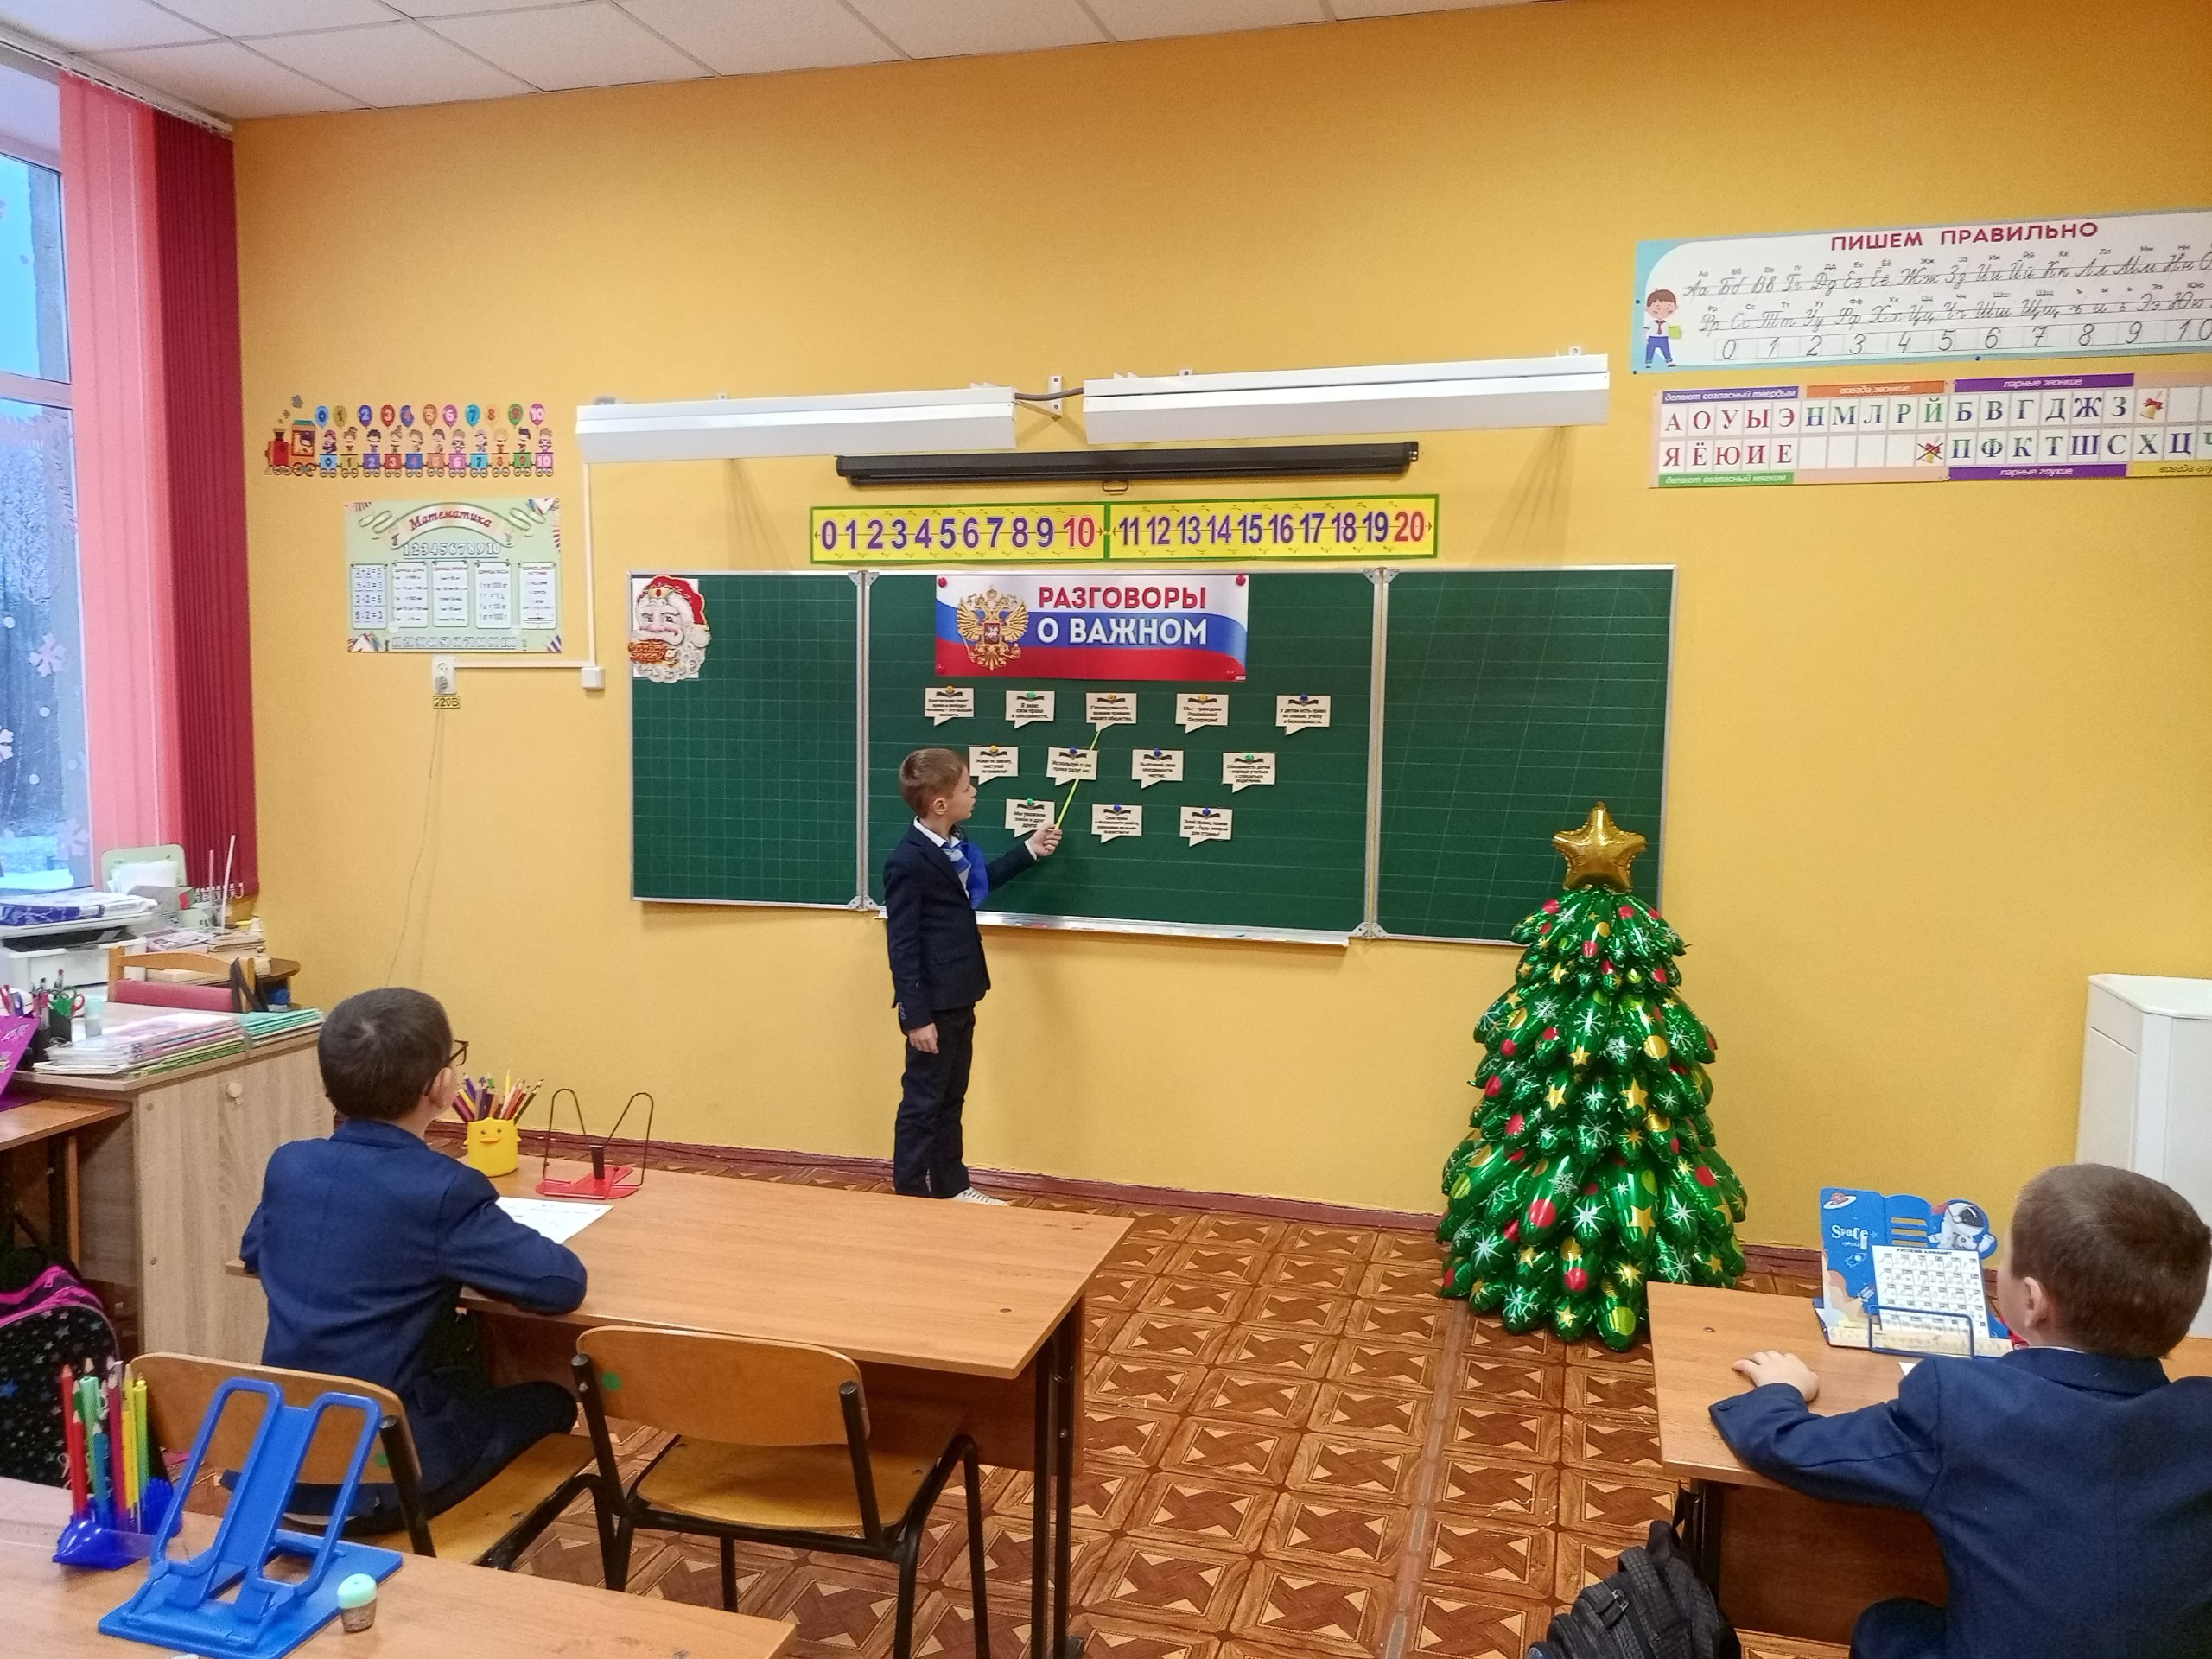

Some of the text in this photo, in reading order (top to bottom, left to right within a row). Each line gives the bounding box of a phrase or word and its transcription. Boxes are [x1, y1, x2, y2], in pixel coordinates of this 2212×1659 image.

[1832, 221, 2098, 251] ПИШЕМ ПРАВИЛЬНО
[1722, 340, 1736, 359] 0
[1769, 337, 1780, 357] 1
[1807, 336, 1822, 356] 2
[1849, 334, 1866, 354] 3
[1898, 332, 1910, 353] 4
[1938, 330, 1956, 351] 5
[1986, 327, 2001, 349] 6
[2032, 326, 2048, 346] 7
[2078, 324, 2094, 346] 8
[2126, 321, 2142, 344] 9
[1665, 397, 2126, 431] А О У Ы Э Н М Л Р Й Б В Г Д Ж З
[1663, 433, 2192, 466] Я Ё Ю И Е П Ф К Т Ш С Х Ц
[409, 509, 492, 530] Математика
[822, 517, 1095, 549] 0 1 2 3 4 5 6 7 8 9 10
[1120, 512, 1424, 545] 11 12 13 14 15 16 17 18 19 20
[1039, 587, 1206, 608] РАЗГОВОРЫ
[1038, 619, 1207, 645] О ВАЖНОМ
